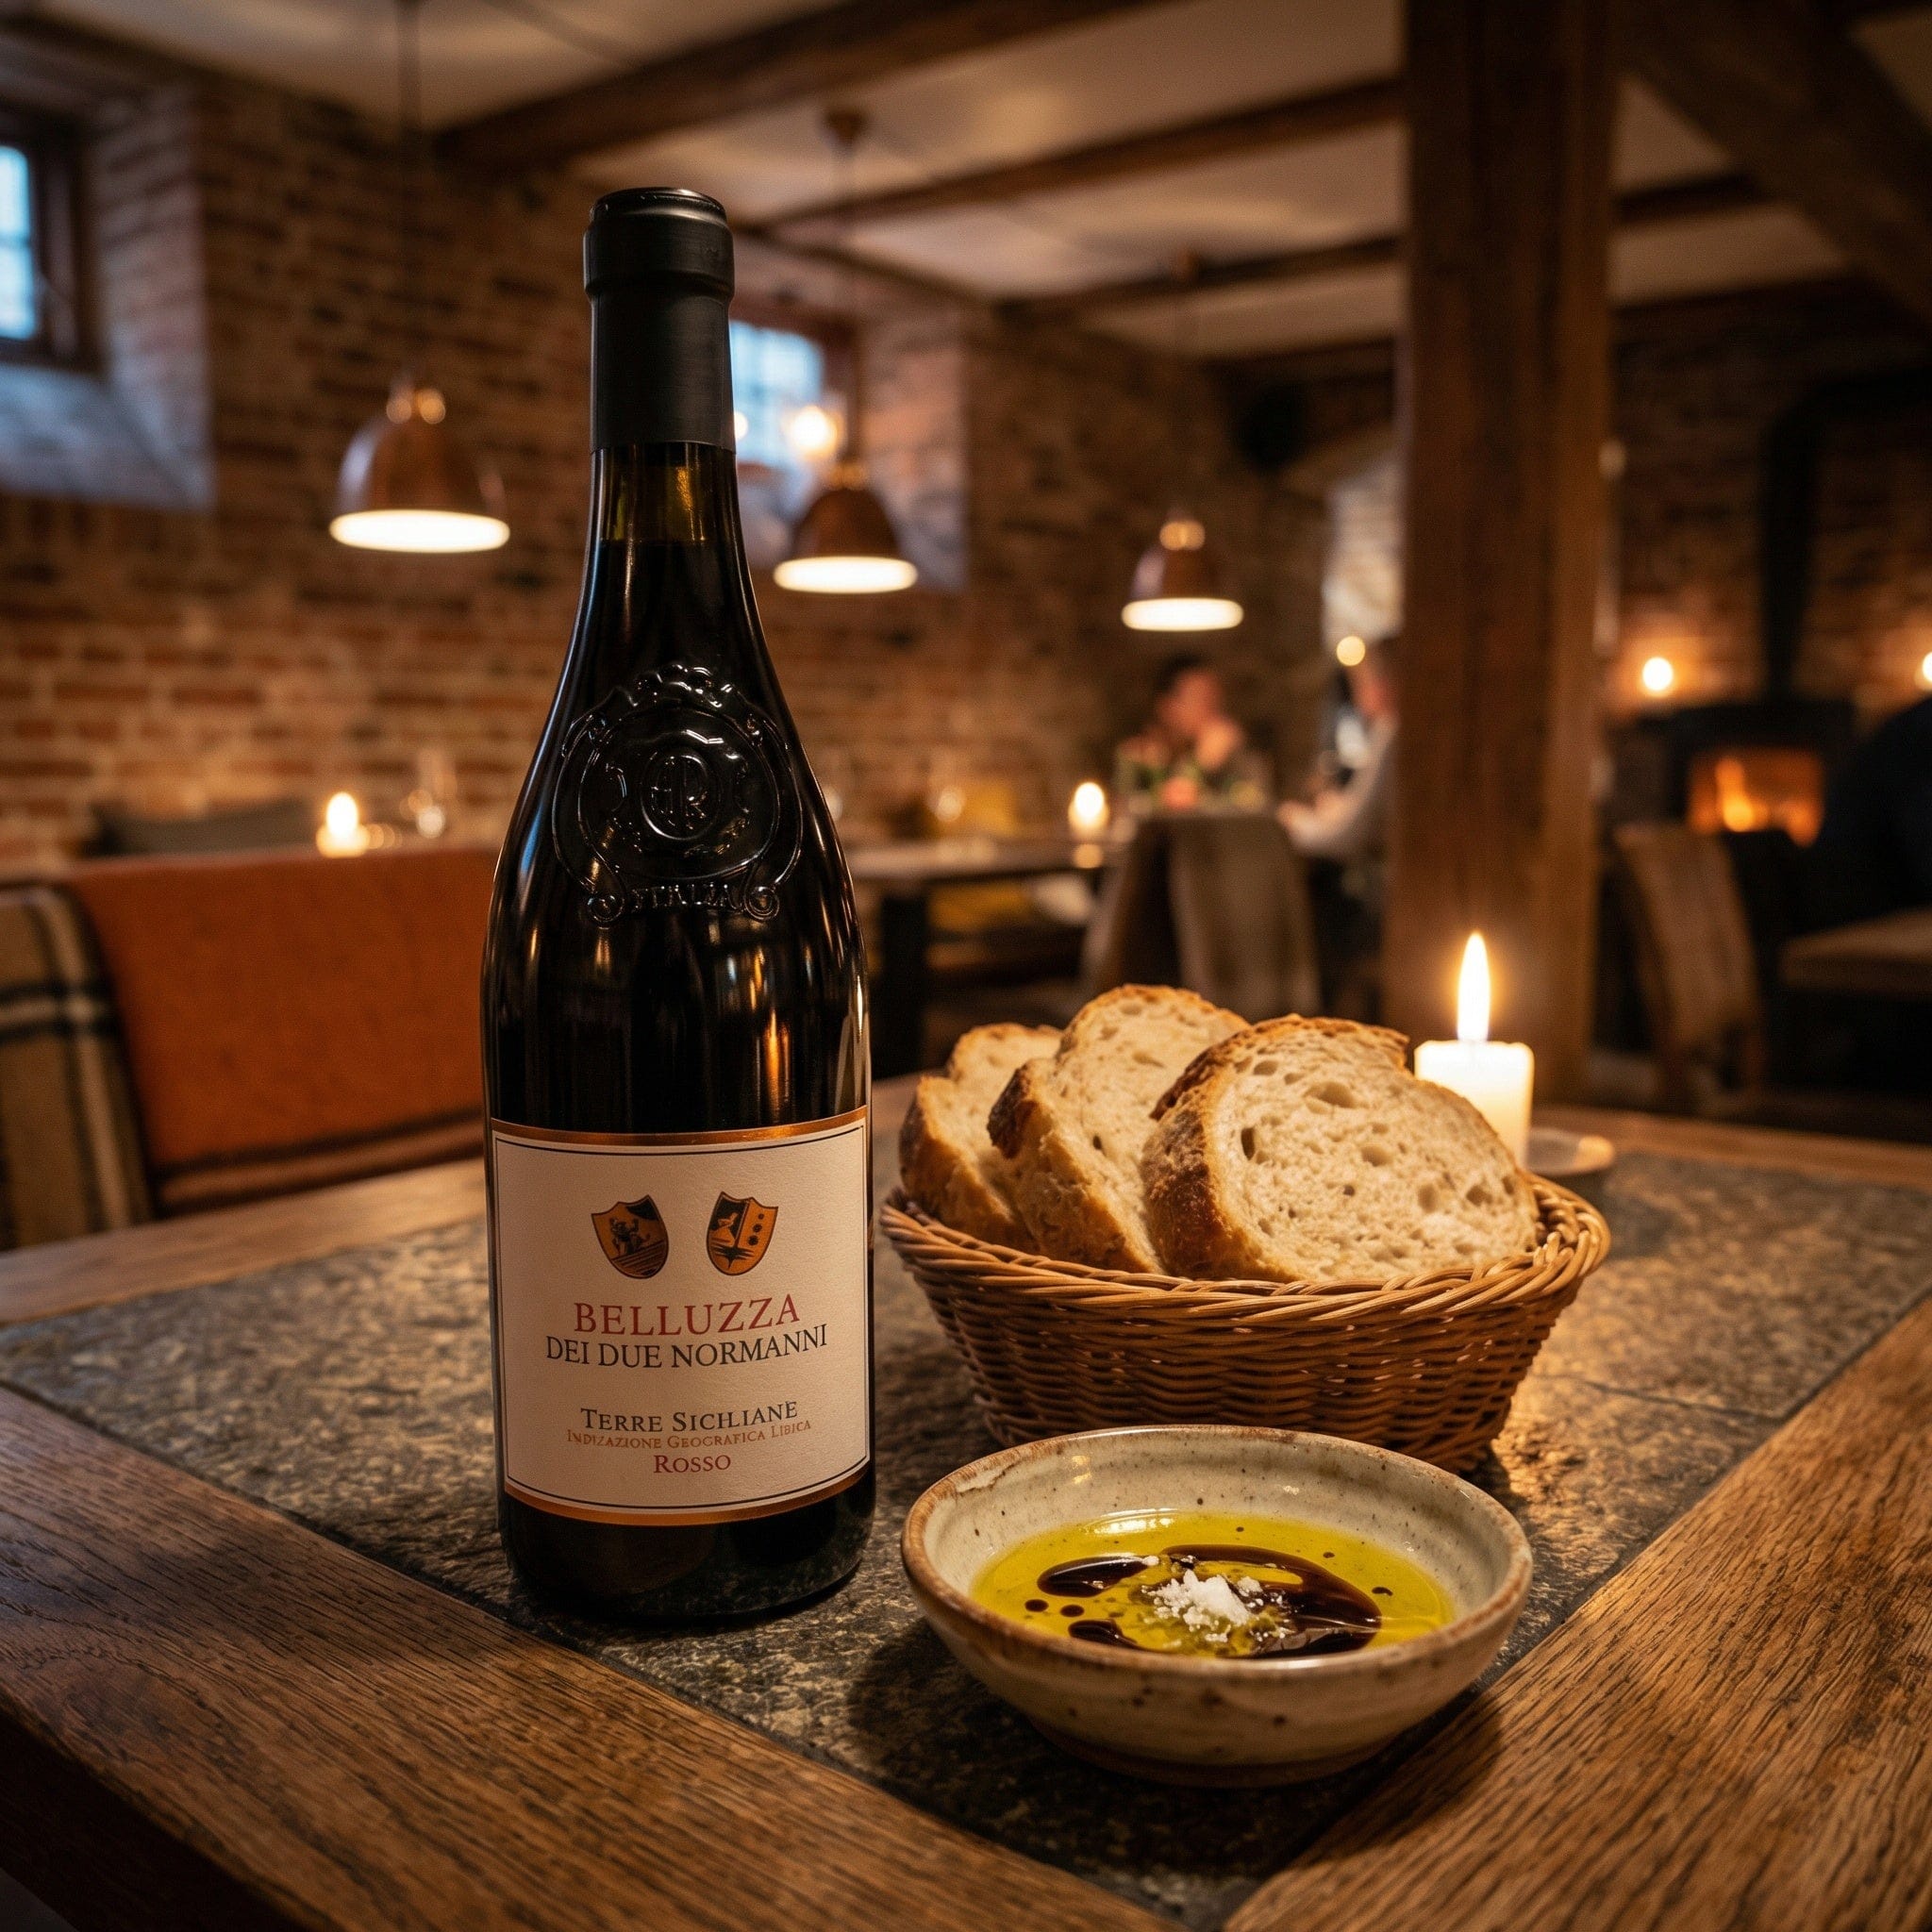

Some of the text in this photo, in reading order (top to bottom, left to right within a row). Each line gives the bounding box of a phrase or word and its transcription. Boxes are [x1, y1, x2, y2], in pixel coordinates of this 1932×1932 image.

[574, 1293, 800, 1336] BELLUZZA
[546, 1324, 827, 1368] DEI DUE NORMANNI
[580, 1407, 663, 1432] TERRE
[653, 1455, 731, 1474] ROSSO
